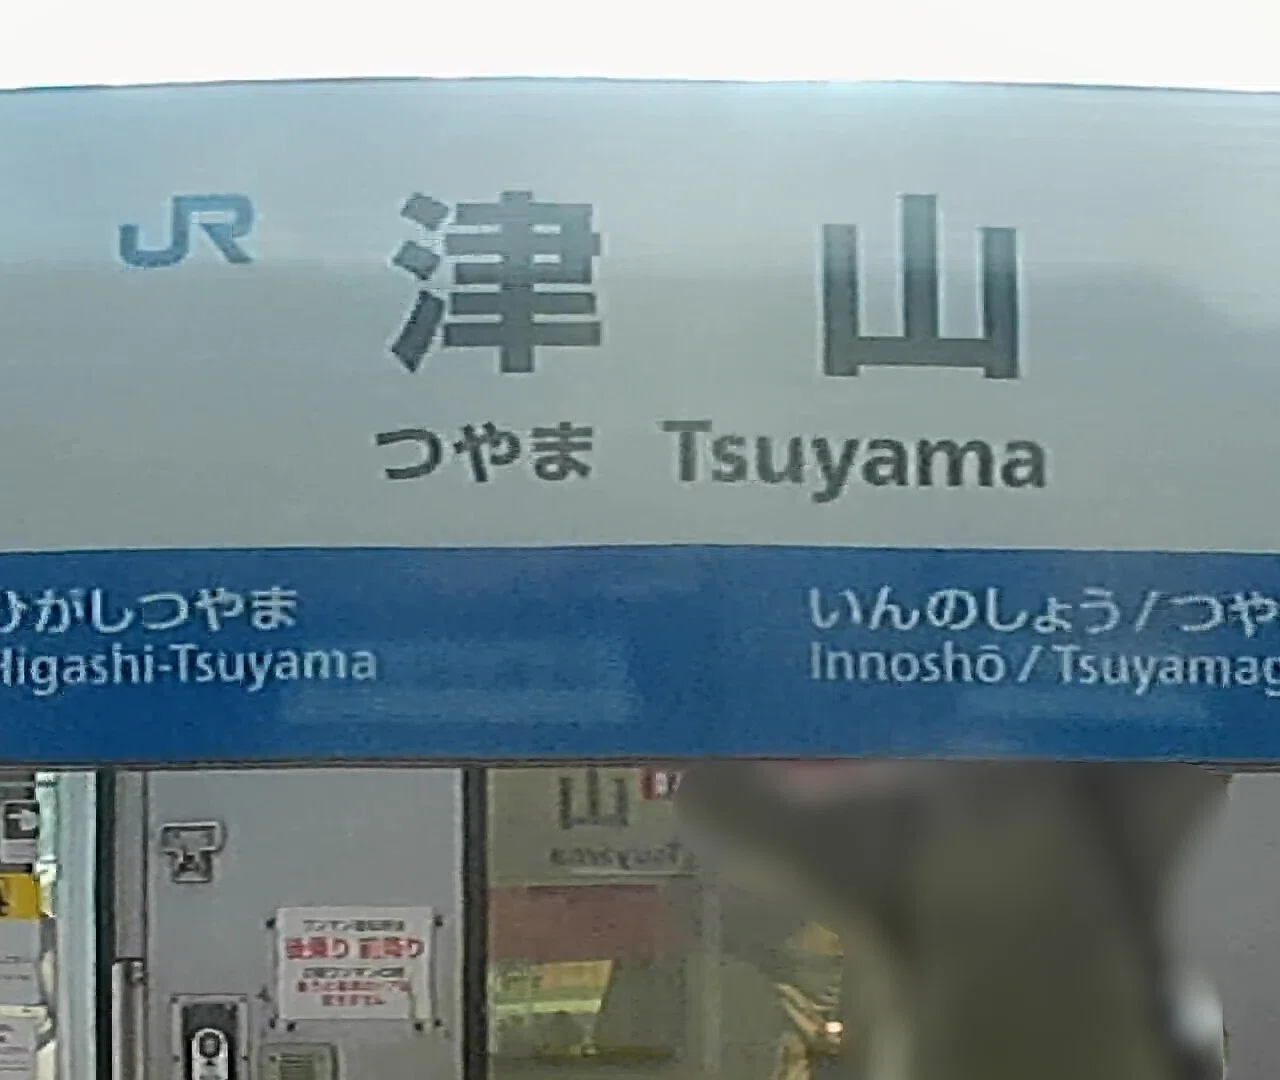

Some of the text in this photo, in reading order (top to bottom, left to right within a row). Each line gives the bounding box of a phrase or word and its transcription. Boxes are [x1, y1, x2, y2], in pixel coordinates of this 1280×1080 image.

[118, 194, 254, 268] JR
[391, 189, 1021, 380] 津山
[376, 420, 594, 483] つやま
[662, 420, 1046, 503] Tsuyama
